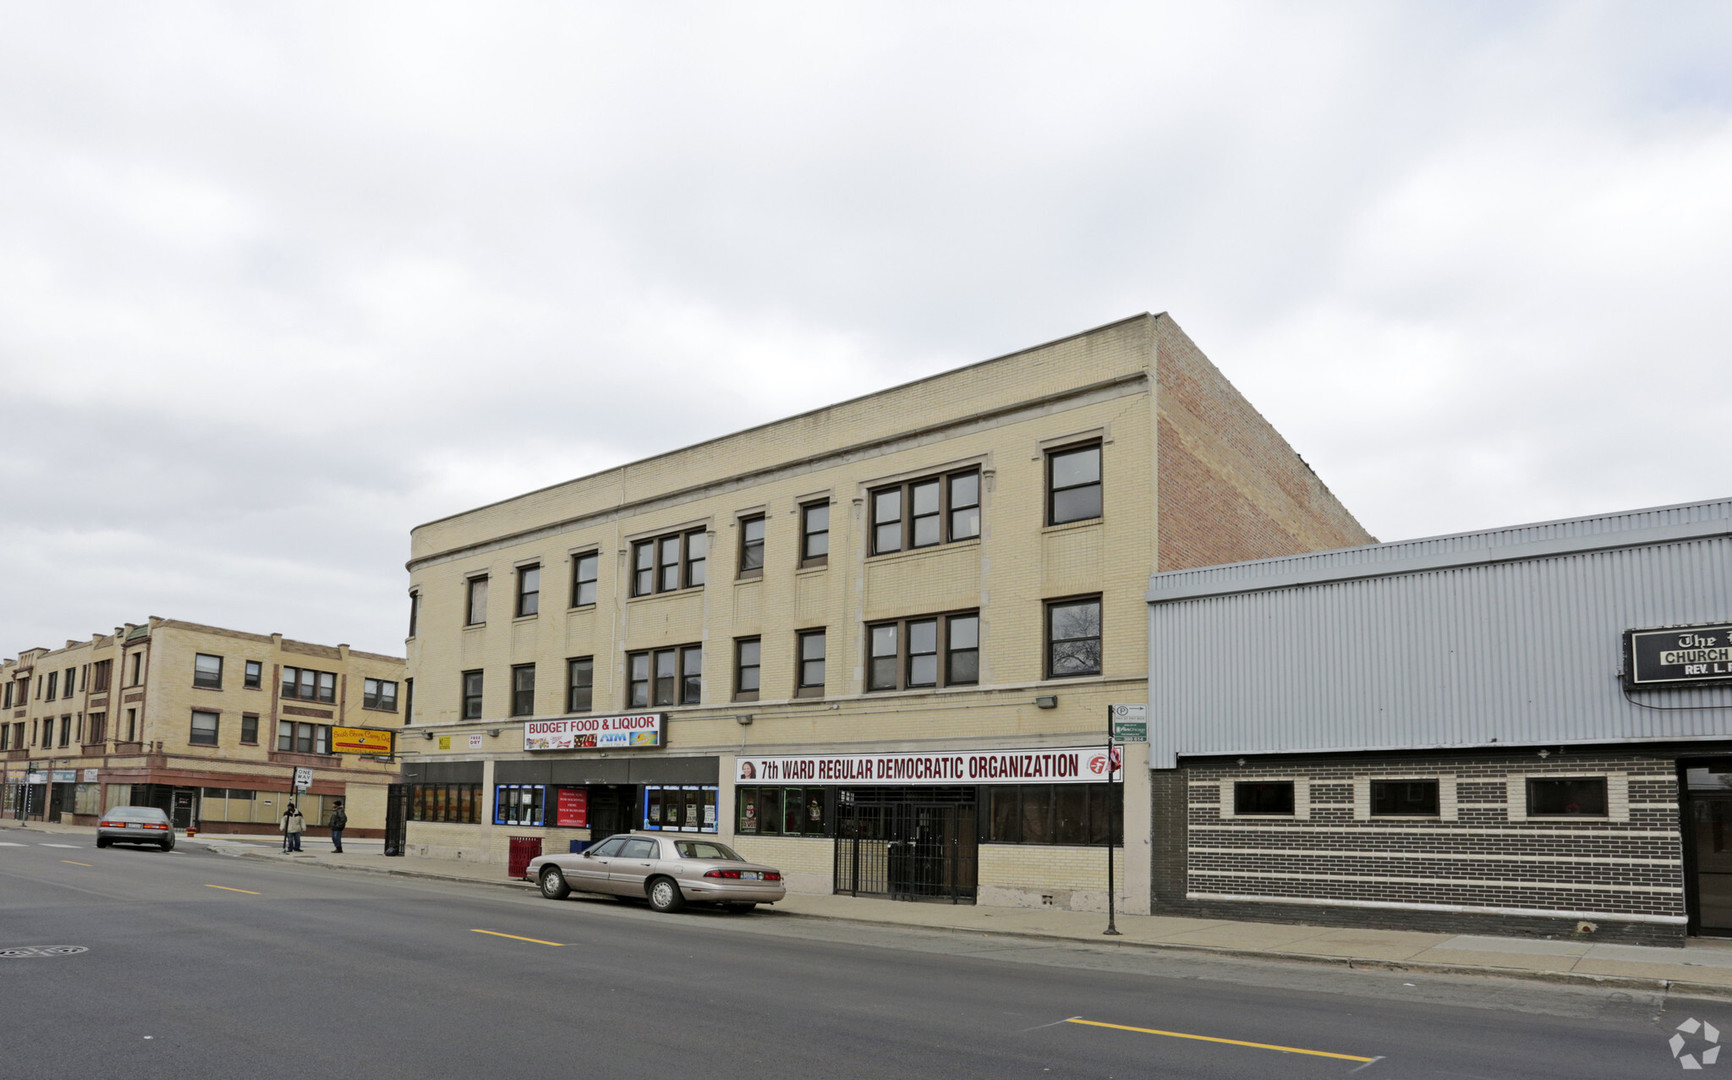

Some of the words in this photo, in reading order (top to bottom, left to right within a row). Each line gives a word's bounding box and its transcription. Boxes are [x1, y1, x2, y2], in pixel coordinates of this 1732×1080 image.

[1679, 633, 1717, 649] The
[1665, 648, 1728, 664] CHURCH
[1685, 664, 1708, 675] REV.
[1714, 663, 1726, 673] L.
[529, 721, 568, 734] BUDGET
[571, 719, 599, 732] FOOD
[602, 719, 609, 730] &
[613, 716, 654, 730] LIQUOR
[600, 733, 626, 742] ATM
[761, 761, 779, 779] 7th
[782, 760, 815, 780] WARD
[818, 759, 873, 780] REGULAR
[877, 756, 964, 779] DEMOCRATIC
[969, 753, 1079, 779] ORGANIZATION
